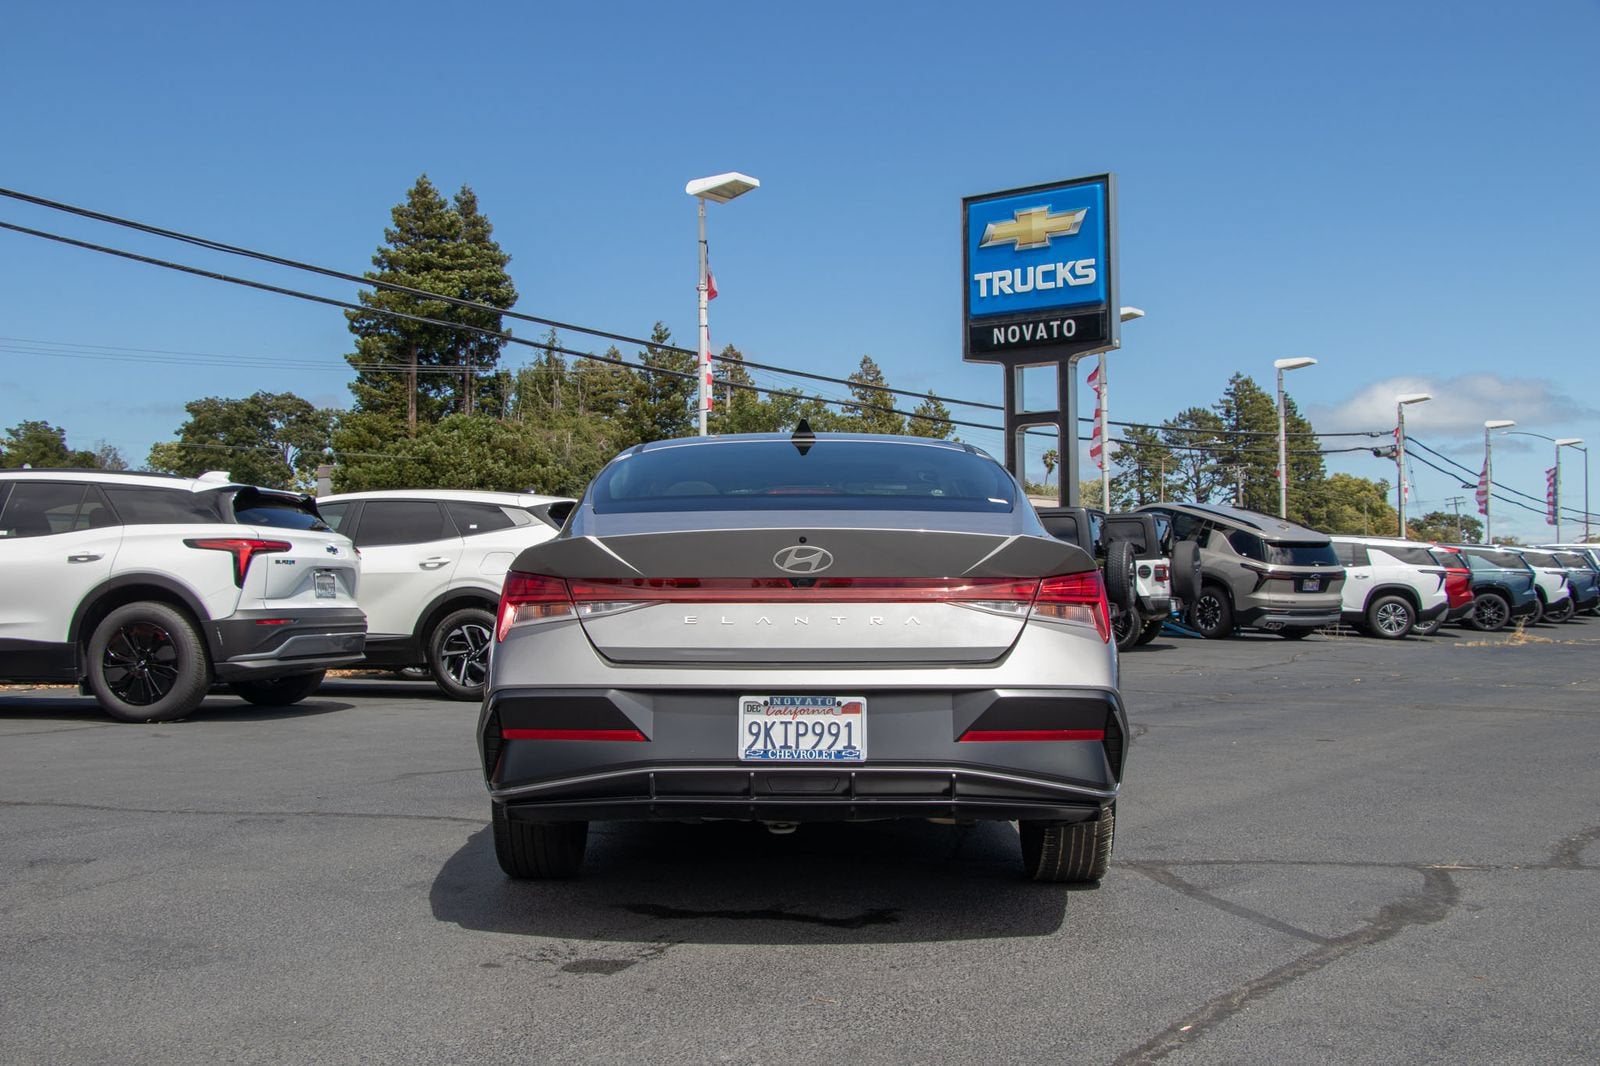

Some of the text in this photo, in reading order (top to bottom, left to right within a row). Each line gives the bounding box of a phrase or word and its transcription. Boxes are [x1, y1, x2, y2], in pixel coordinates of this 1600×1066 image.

[974, 258, 1097, 298] TRUCKS
[993, 319, 1077, 345] NOVATO
[684, 616, 921, 625] ELANTRA
[773, 697, 833, 706] NOVATO
[747, 704, 761, 713] DEC
[766, 706, 836, 720] California
[747, 720, 857, 750] 9KIP991
[768, 749, 837, 760] CHEVROLET
